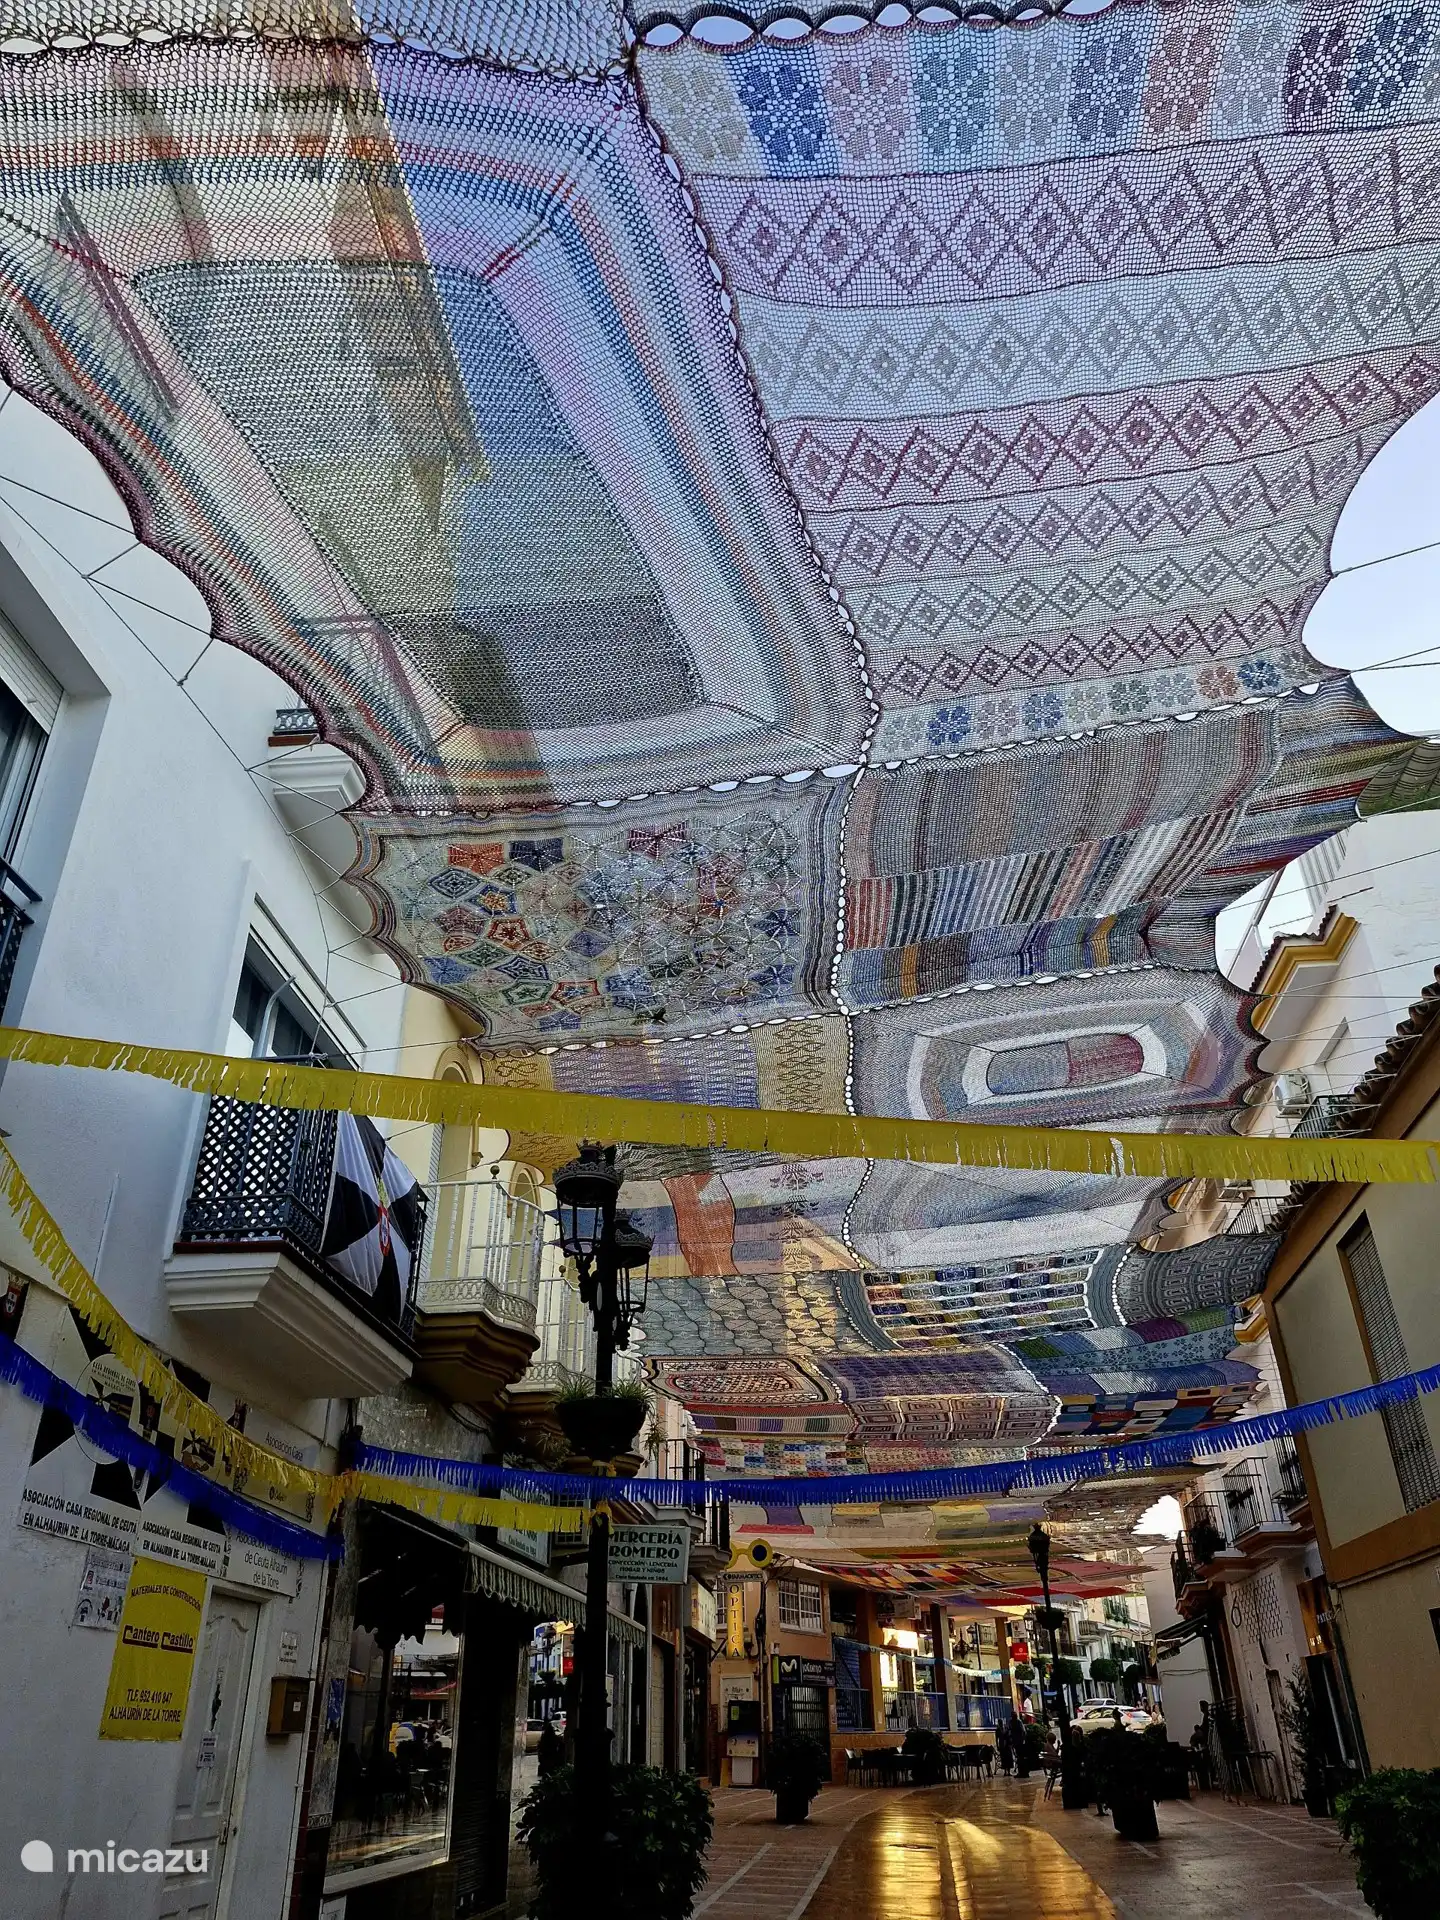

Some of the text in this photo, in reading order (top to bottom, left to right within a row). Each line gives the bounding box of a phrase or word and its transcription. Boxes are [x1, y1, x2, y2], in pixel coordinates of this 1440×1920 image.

[292, 1445, 304, 1462] Casa
[22, 1488, 137, 1534] ASOCIACIÓN CASA REGIONAL DE CEUTA
[23, 1512, 34, 1526] EN
[69, 1525, 79, 1538] DE
[80, 1528, 88, 1541] LA
[142, 1520, 221, 1554] ASOCIACIÓN CASA REGIONAL DE CEUTA
[608, 1530, 683, 1545] MERCERÍA
[142, 1539, 150, 1550] EN
[172, 1548, 179, 1559] DE
[180, 1550, 187, 1561] LA
[609, 1545, 680, 1560] ROMERO
[244, 1551, 253, 1564] de
[253, 1552, 269, 1569] Ceuta
[253, 1572, 279, 1590] de la Torre
[131, 1584, 201, 1611] MATERIALES DE CONSTRUCCIÓN
[122, 1624, 193, 1654] Cantero Castillo
[140, 1690, 150, 1703] 952
[151, 1691, 161, 1704] 410
[161, 1692, 172, 1704] 847
[143, 1708, 152, 1721] DE
[152, 1709, 161, 1722] LA
[161, 1710, 182, 1723] TORRE
